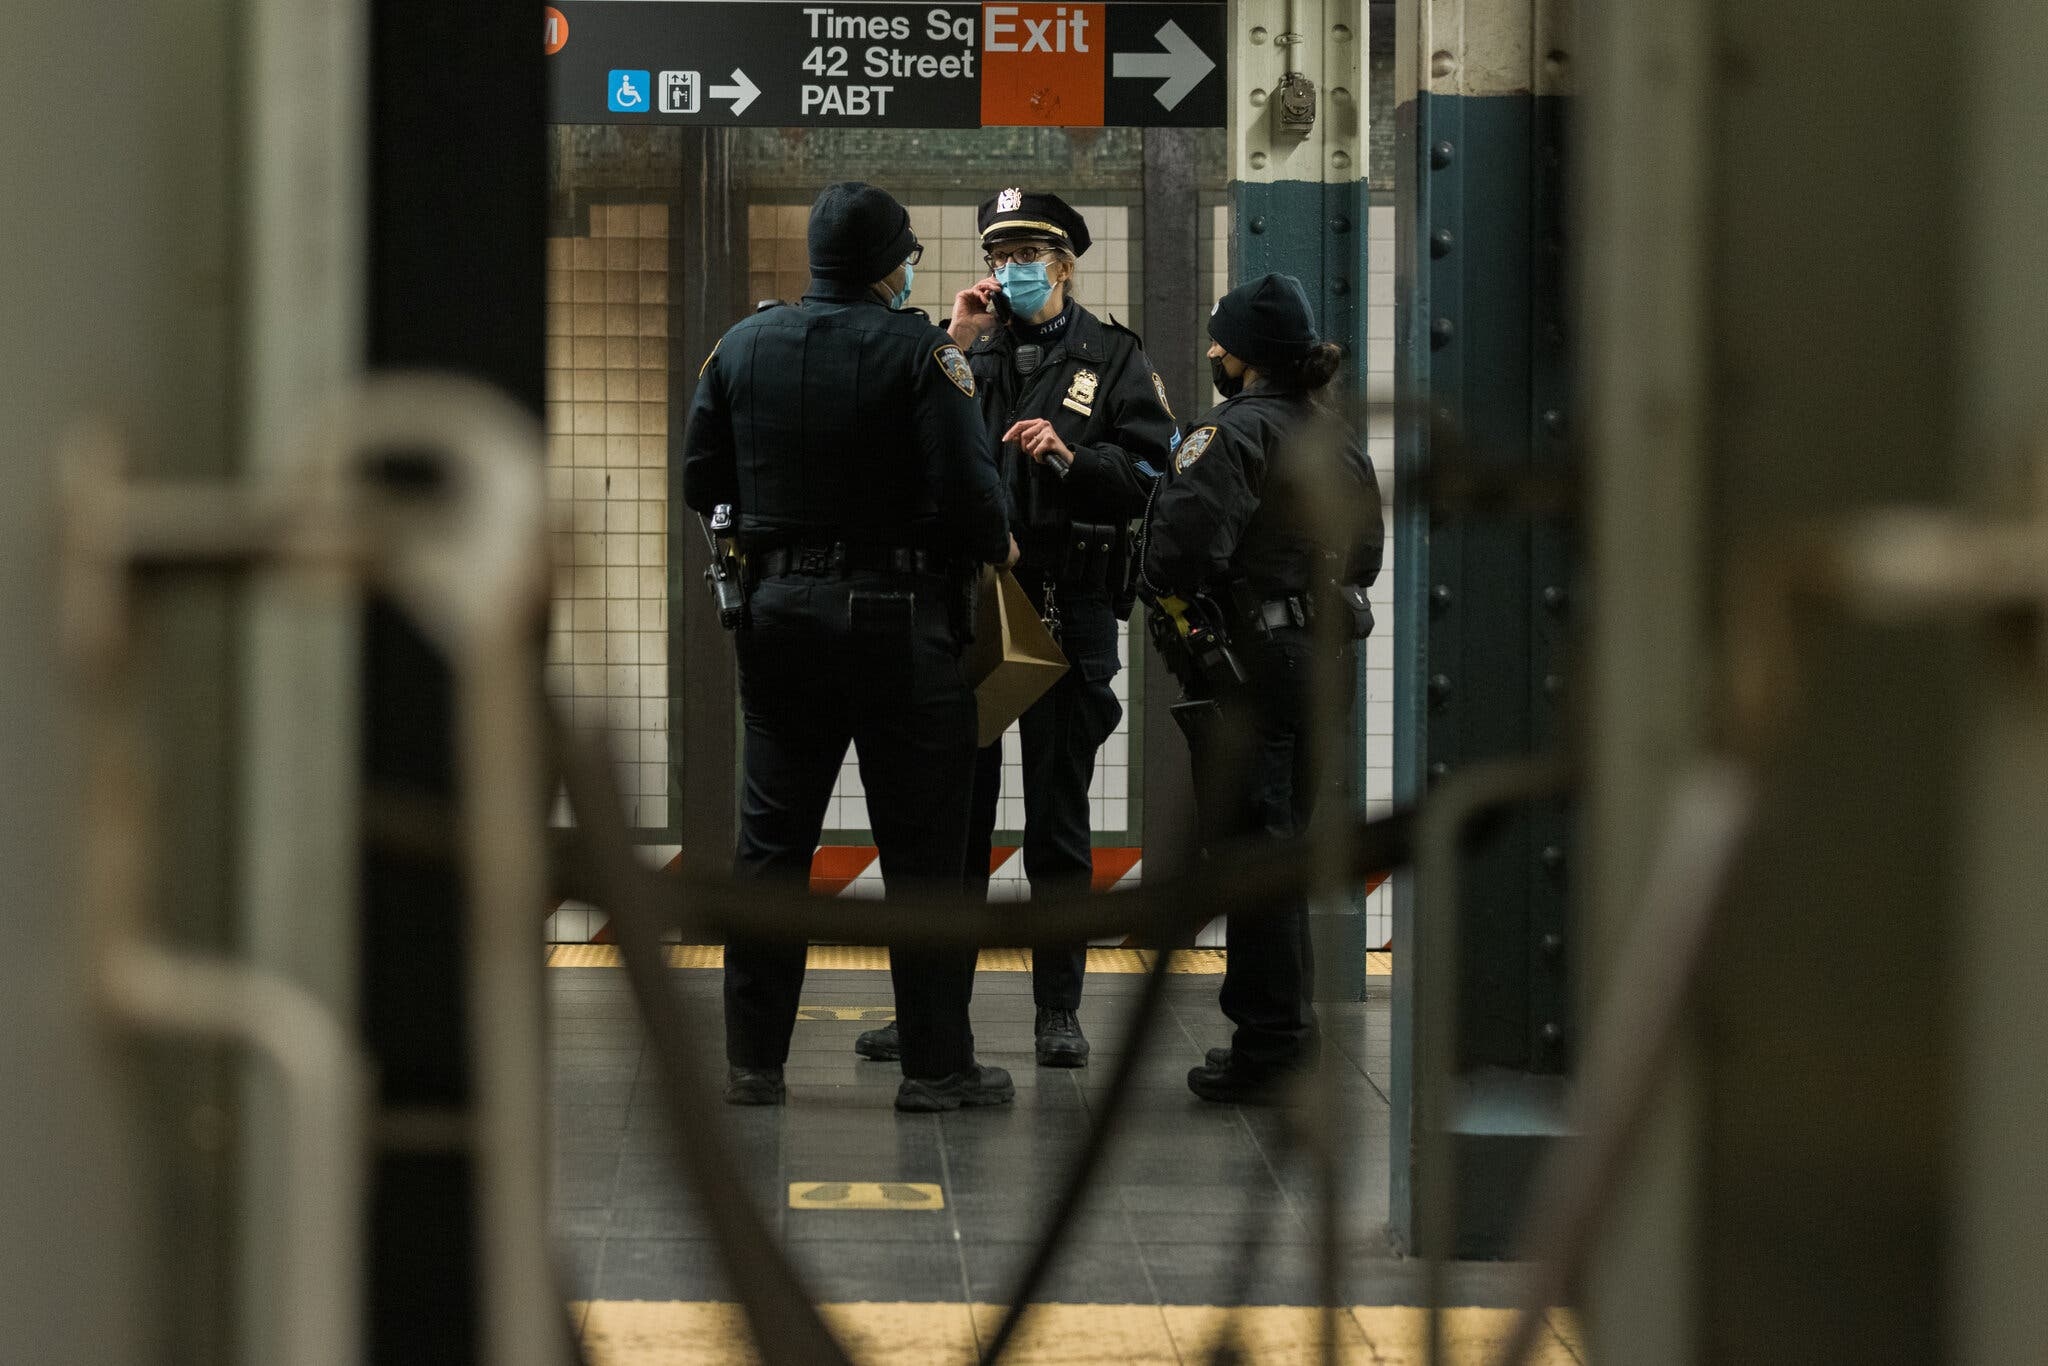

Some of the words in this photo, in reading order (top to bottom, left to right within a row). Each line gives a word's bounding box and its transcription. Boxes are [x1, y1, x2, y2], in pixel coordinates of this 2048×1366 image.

[803, 9, 910, 40] Times
[926, 9, 975, 47] Sq
[984, 7, 1089, 53] Exit
[802, 46, 848, 77] 42
[864, 47, 975, 79] Street
[801, 85, 894, 116] PABT
